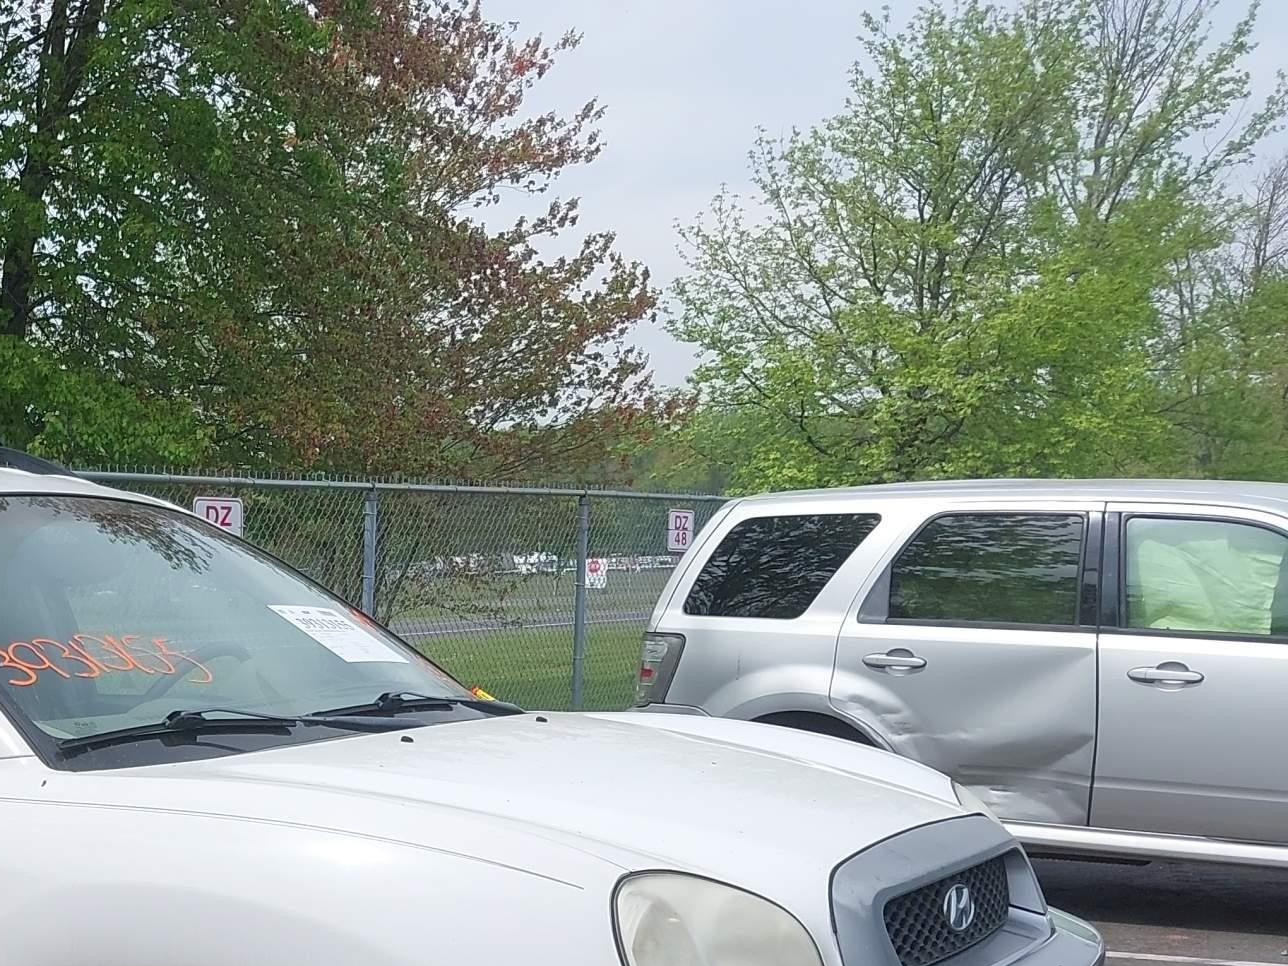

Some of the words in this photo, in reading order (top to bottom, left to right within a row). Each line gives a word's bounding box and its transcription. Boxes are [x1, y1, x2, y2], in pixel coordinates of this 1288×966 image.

[205, 505, 233, 527] DZ
[674, 515, 689, 530] DZ
[674, 531, 688, 546] 48
